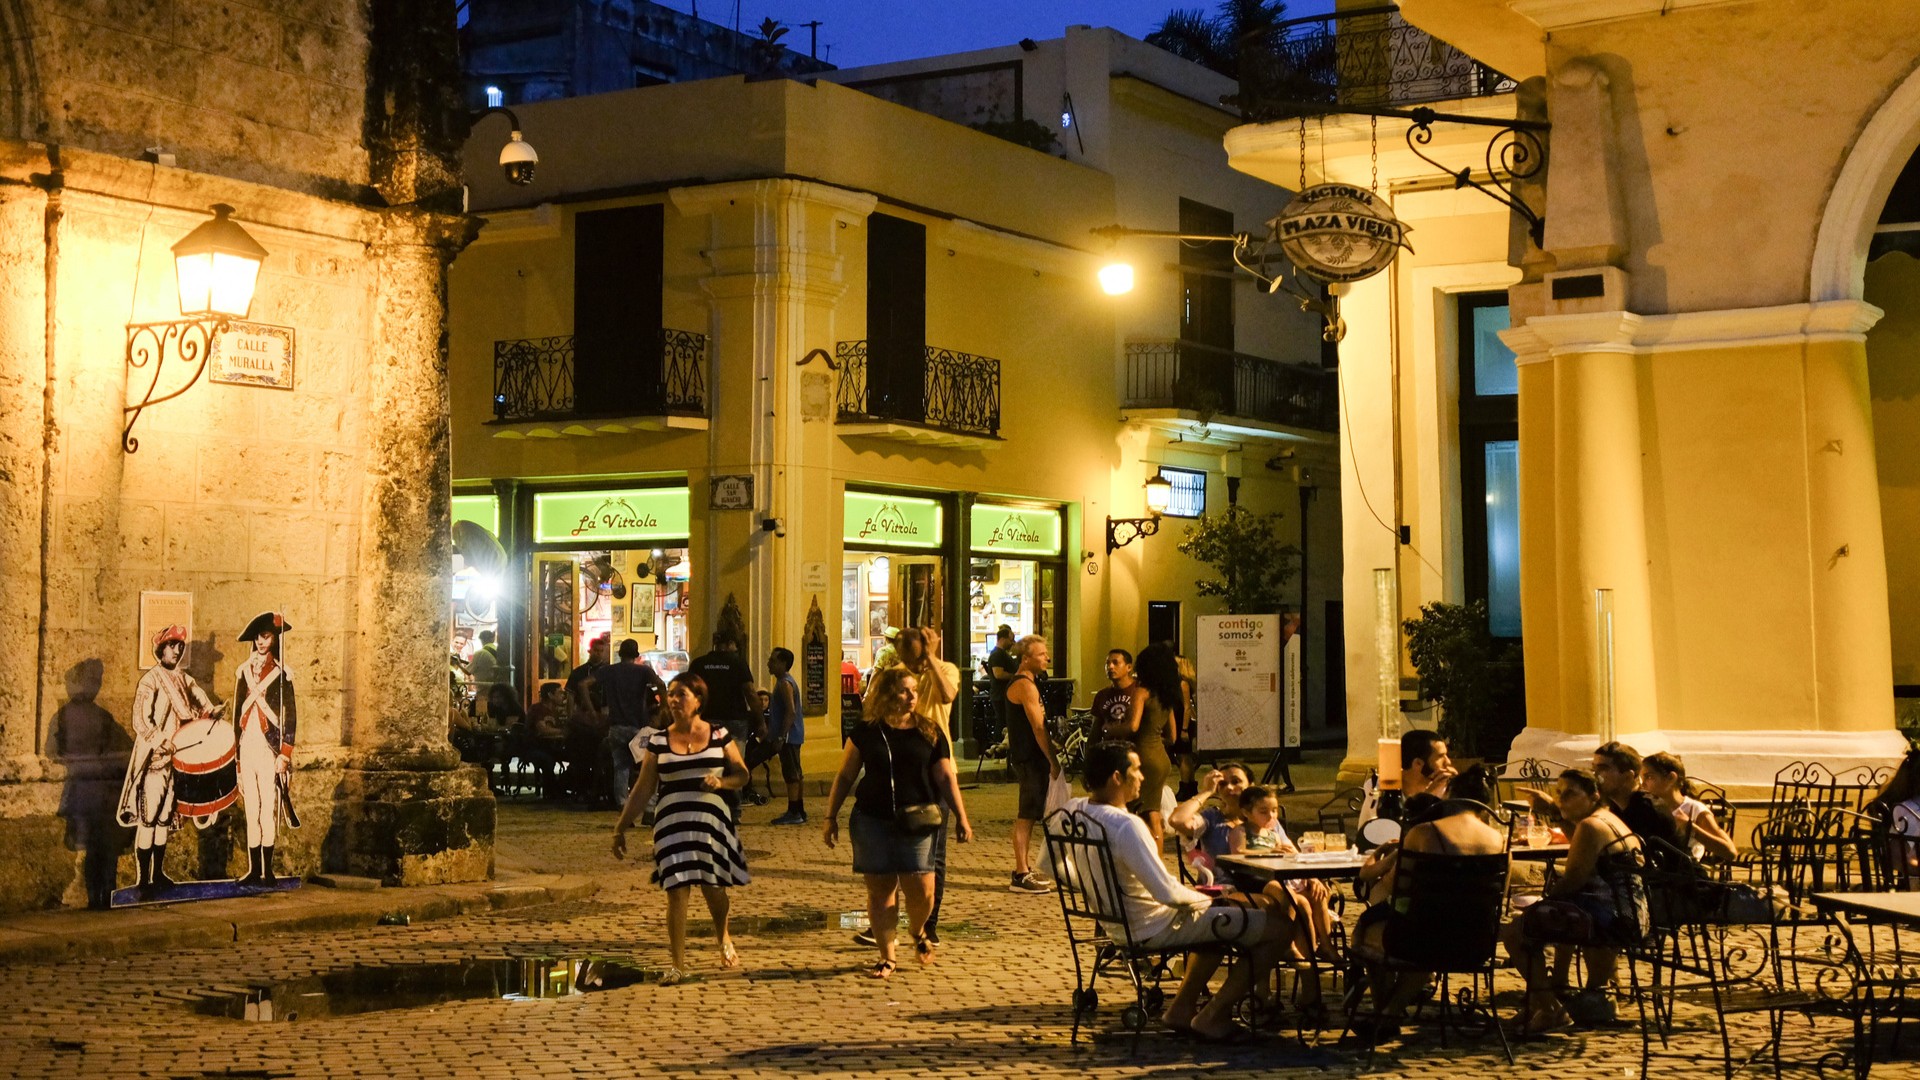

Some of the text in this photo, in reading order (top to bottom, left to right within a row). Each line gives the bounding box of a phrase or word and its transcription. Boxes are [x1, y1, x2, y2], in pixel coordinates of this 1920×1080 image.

[1301, 185, 1373, 206] FACTORIA
[1283, 215, 1393, 239] PLAZA VIEJA
[237, 338, 268, 352] CALLE
[229, 356, 274, 371] MURALLA
[571, 513, 658, 536] La Vitrola
[859, 518, 918, 538] La Vitrola
[988, 527, 1040, 547] La Vitrola
[1218, 618, 1264, 632] contigo
[1218, 631, 1254, 640] somos
